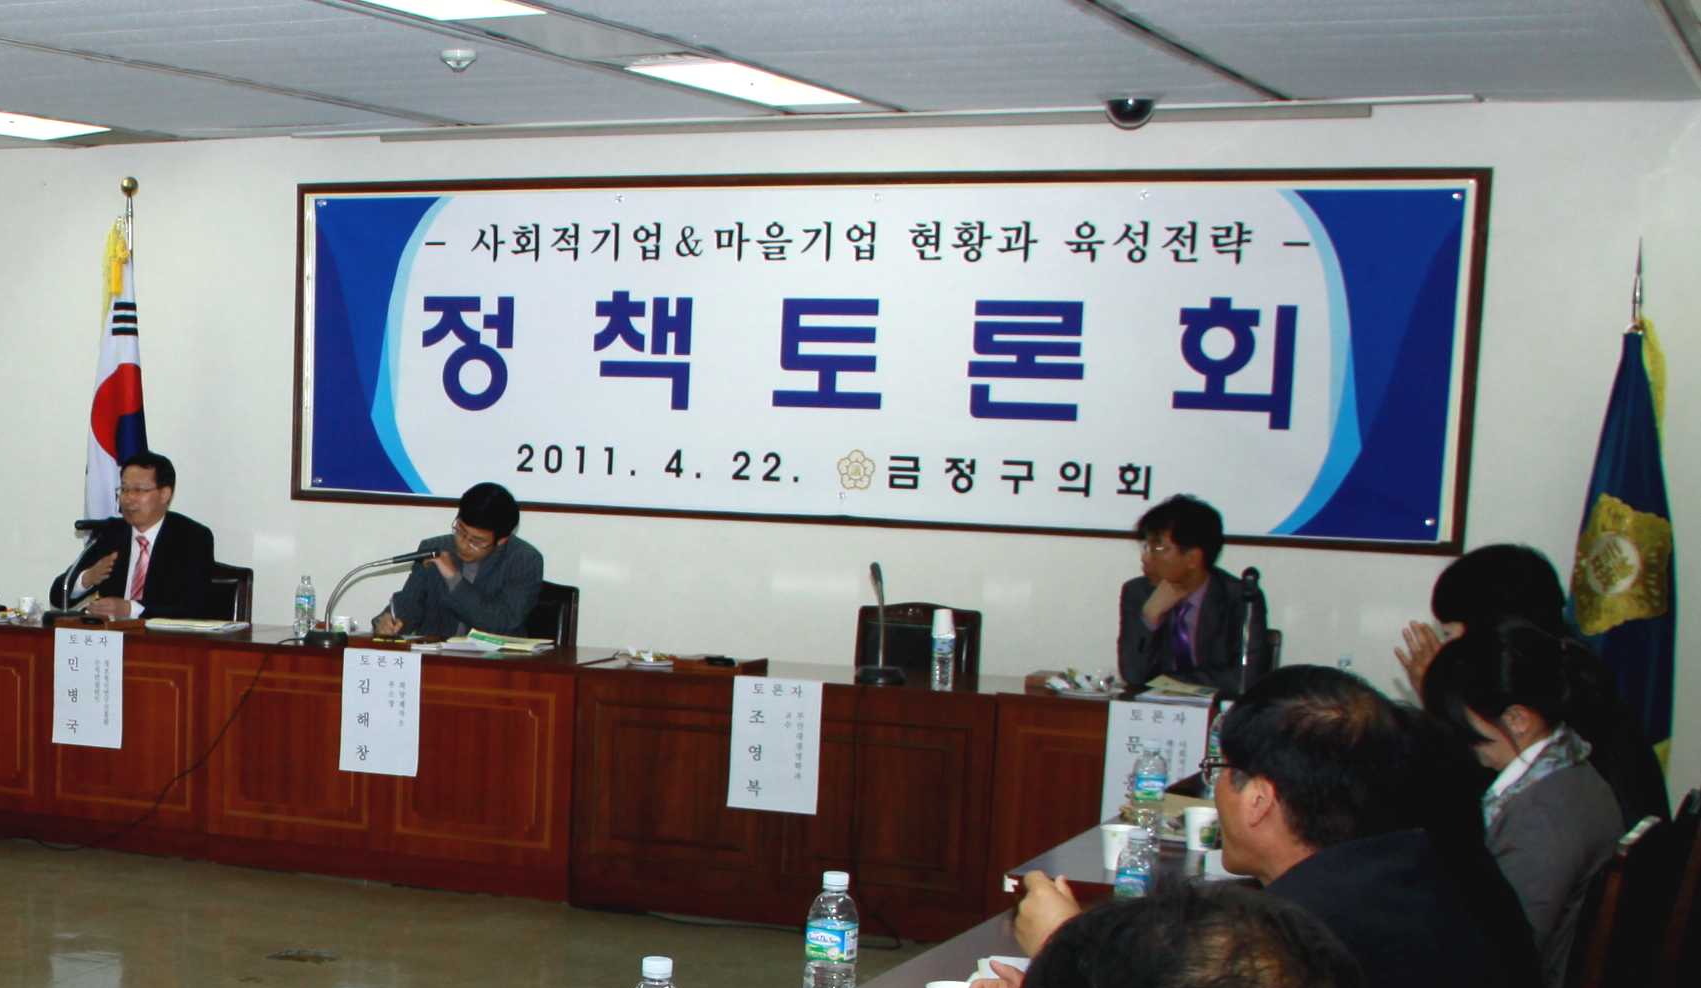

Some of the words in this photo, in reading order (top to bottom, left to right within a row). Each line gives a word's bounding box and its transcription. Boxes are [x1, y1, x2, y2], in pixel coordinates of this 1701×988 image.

[471, 220, 877, 263] 사회적기업&마을기업
[909, 220, 1039, 263] 현황과
[1065, 221, 1254, 265] 육성전략
[516, 443, 637, 478] 2011.
[665, 449, 702, 480] 4.
[731, 450, 800, 484] 22.
[887, 455, 1153, 501] 금정구의회
[69, 634, 108, 647] 토론자
[360, 655, 405, 669] 토론자
[752, 683, 804, 699] 토론자
[356, 678, 370, 762] 김해창
[1130, 708, 1187, 725] 토론자
